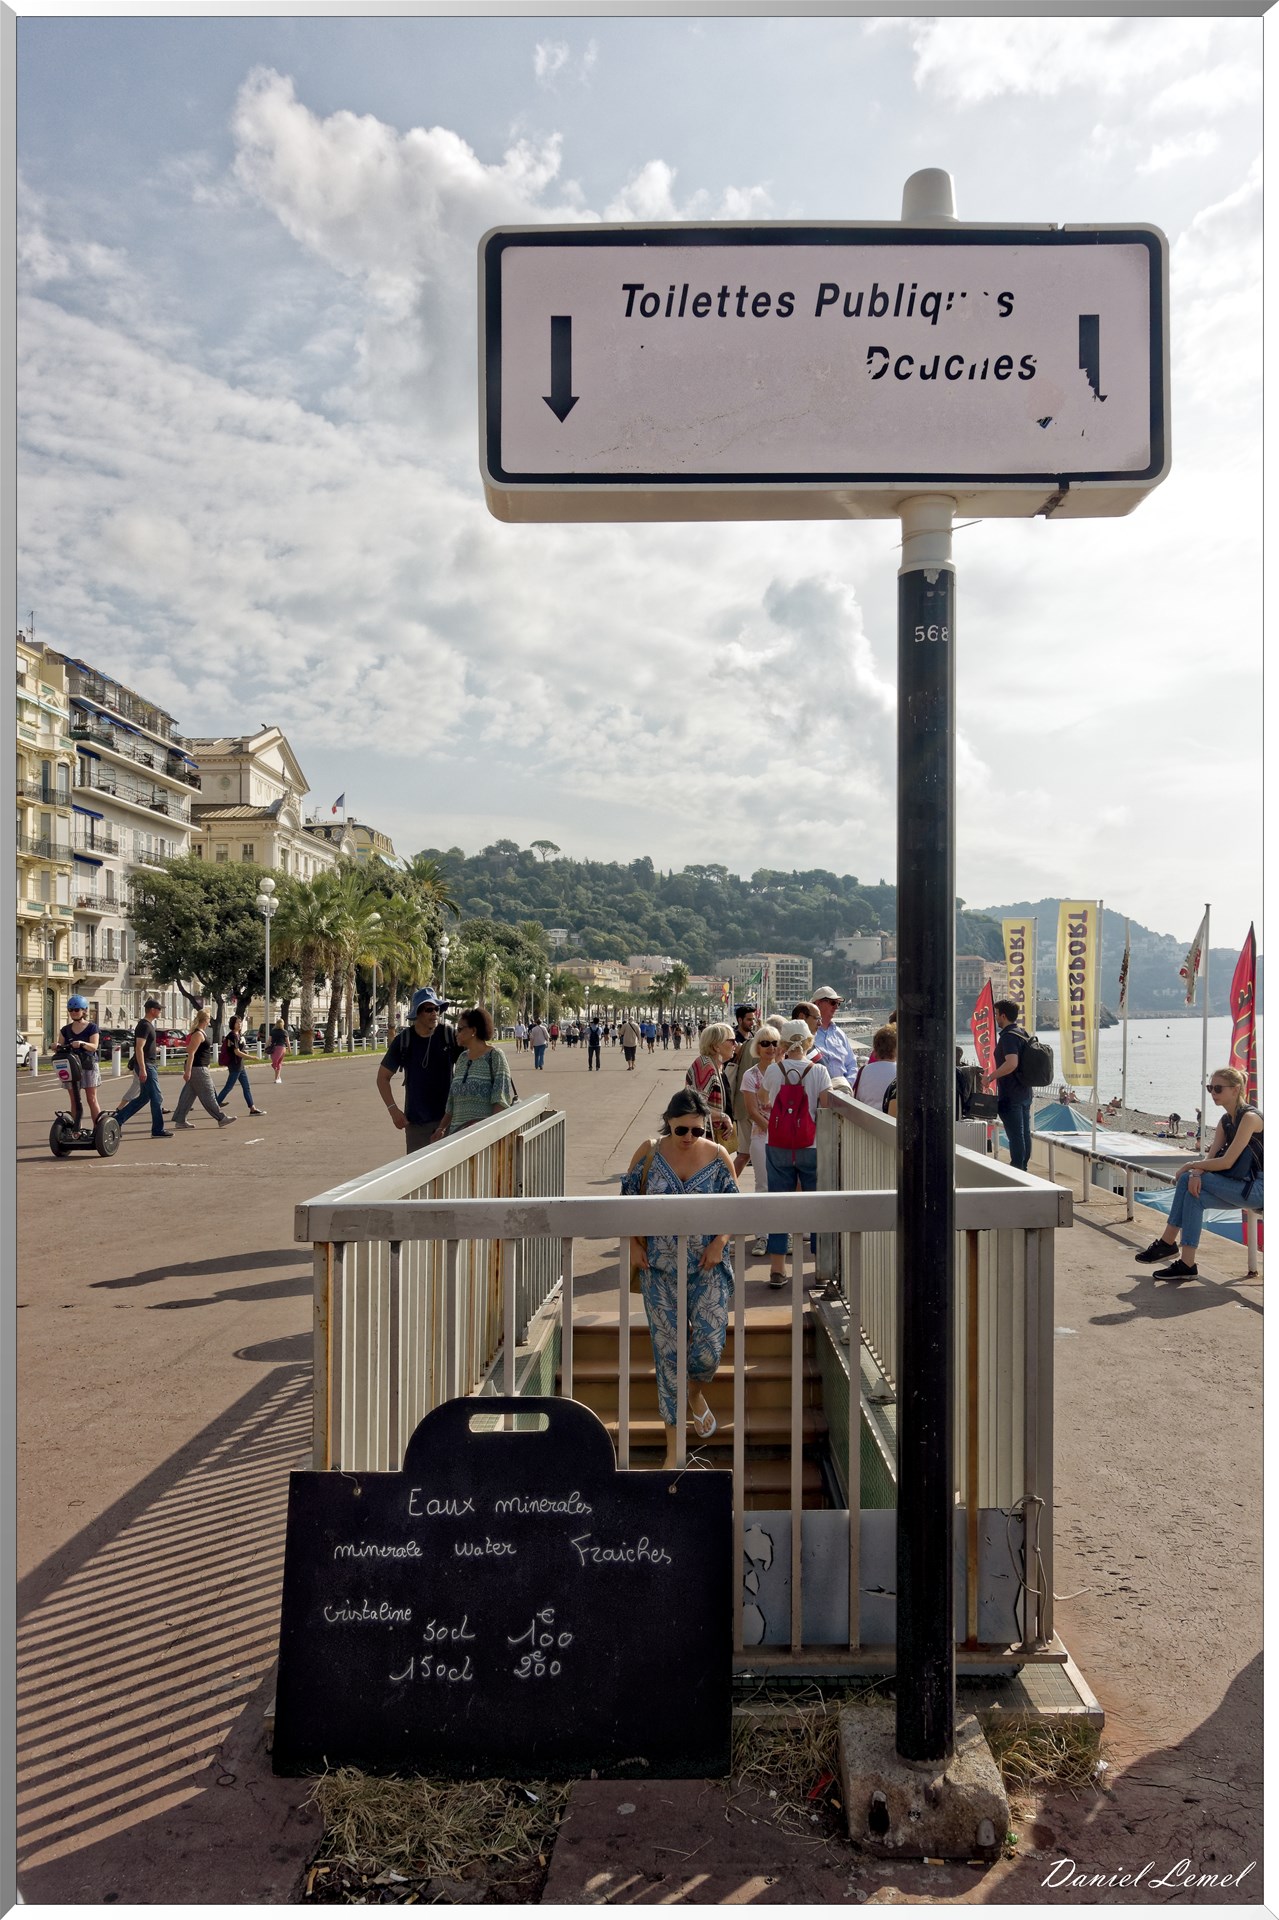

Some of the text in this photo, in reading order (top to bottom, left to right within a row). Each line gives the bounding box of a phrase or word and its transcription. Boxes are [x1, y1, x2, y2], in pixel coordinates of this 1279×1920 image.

[621, 282, 1015, 326] Toilettes Publiqs
[408, 1488, 593, 1516] Eaux minerales
[333, 1532, 672, 1566] minerale water Fraiches
[423, 1614, 476, 1641] 50cl
[388, 1655, 473, 1681] 150cl
